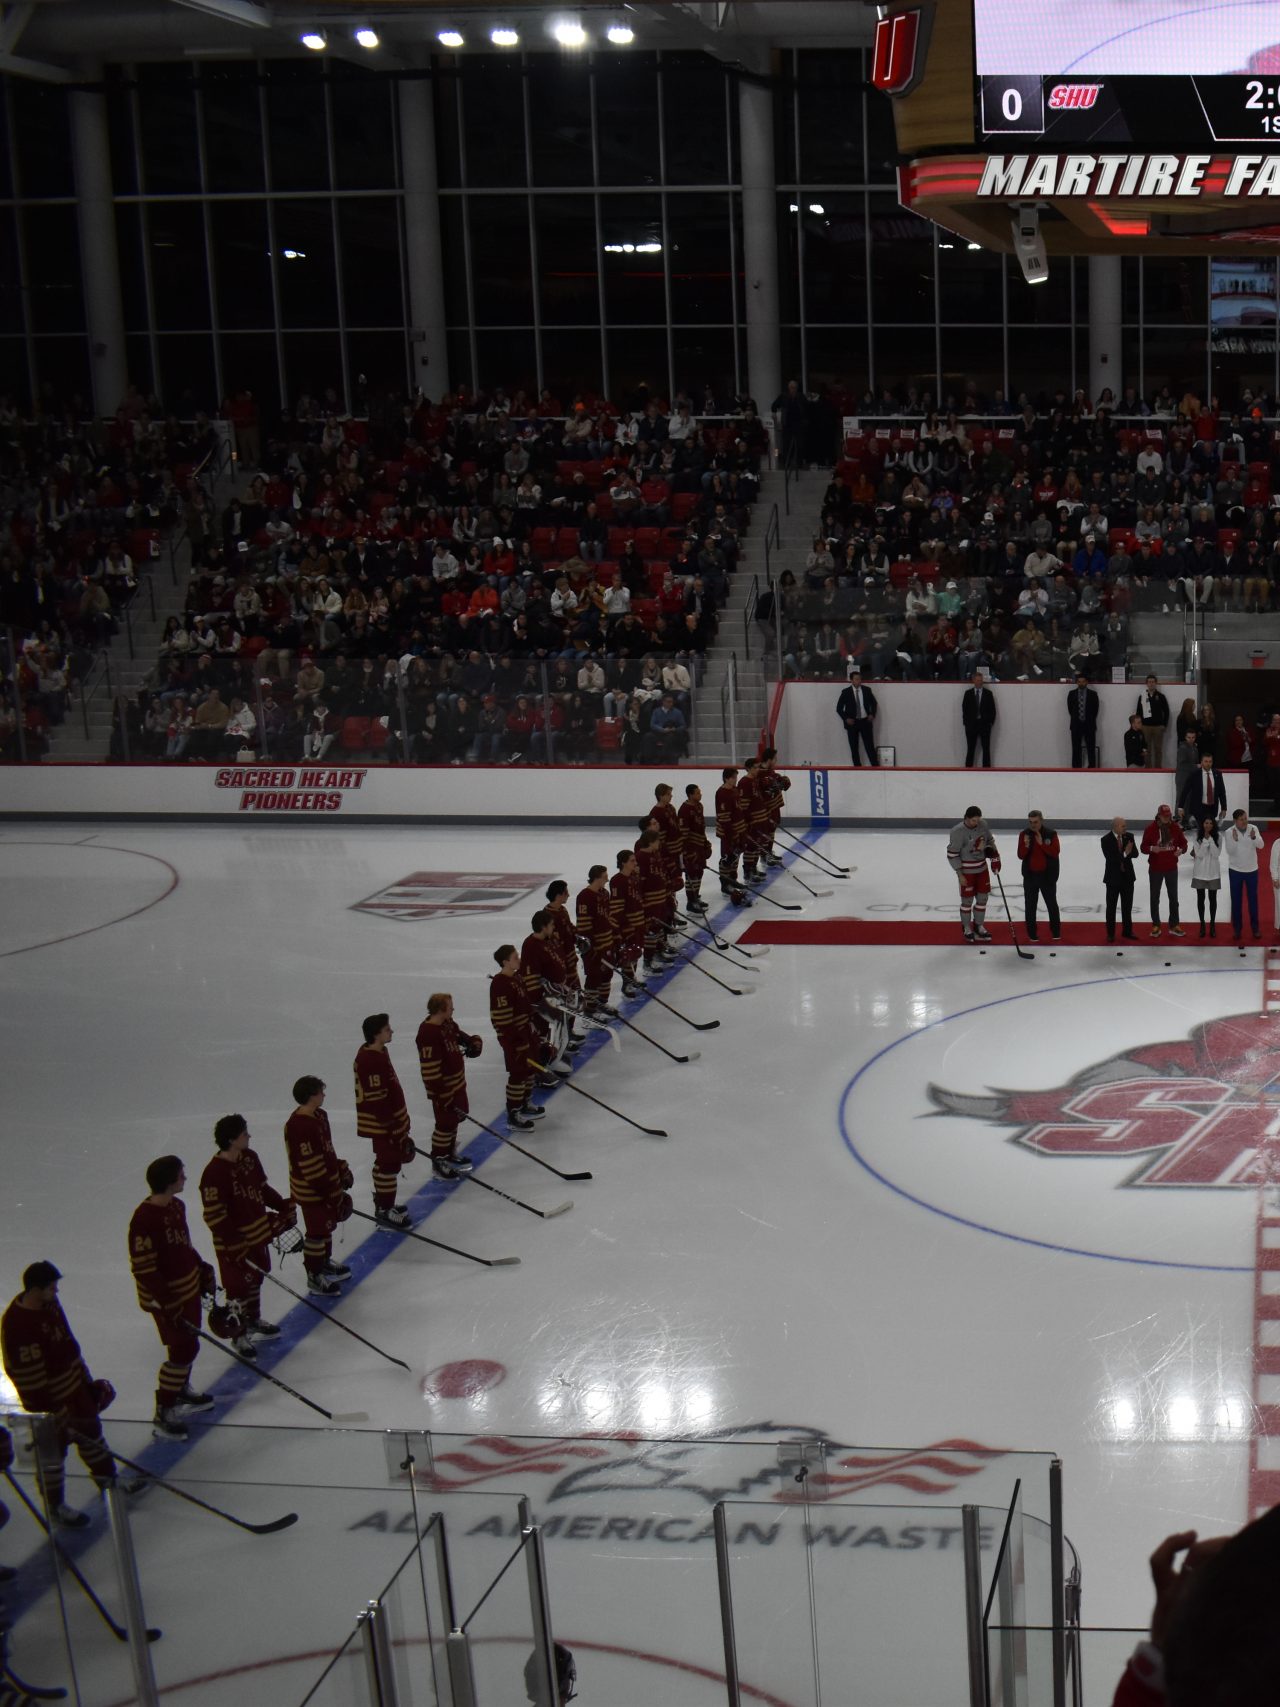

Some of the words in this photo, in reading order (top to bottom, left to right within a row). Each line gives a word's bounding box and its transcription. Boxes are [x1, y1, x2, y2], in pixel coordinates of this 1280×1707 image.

[1002, 88, 1022, 121] 0
[1048, 84, 1104, 109] SHU
[977, 155, 1211, 196] MARTIRE
[215, 769, 296, 788] SACRED
[298, 769, 367, 789] HEART
[239, 791, 343, 811] PIONEERS
[814, 770, 825, 815] CCM
[496, 996, 507, 1008] 15
[422, 1046, 433, 1058] 17
[368, 1074, 381, 1087] 19
[300, 1141, 313, 1156] 21
[135, 1235, 152, 1252] 24
[19, 1343, 42, 1363] 26
[465, 1514, 780, 1546] AMERICAN
[802, 1523, 995, 1550] WASTE
